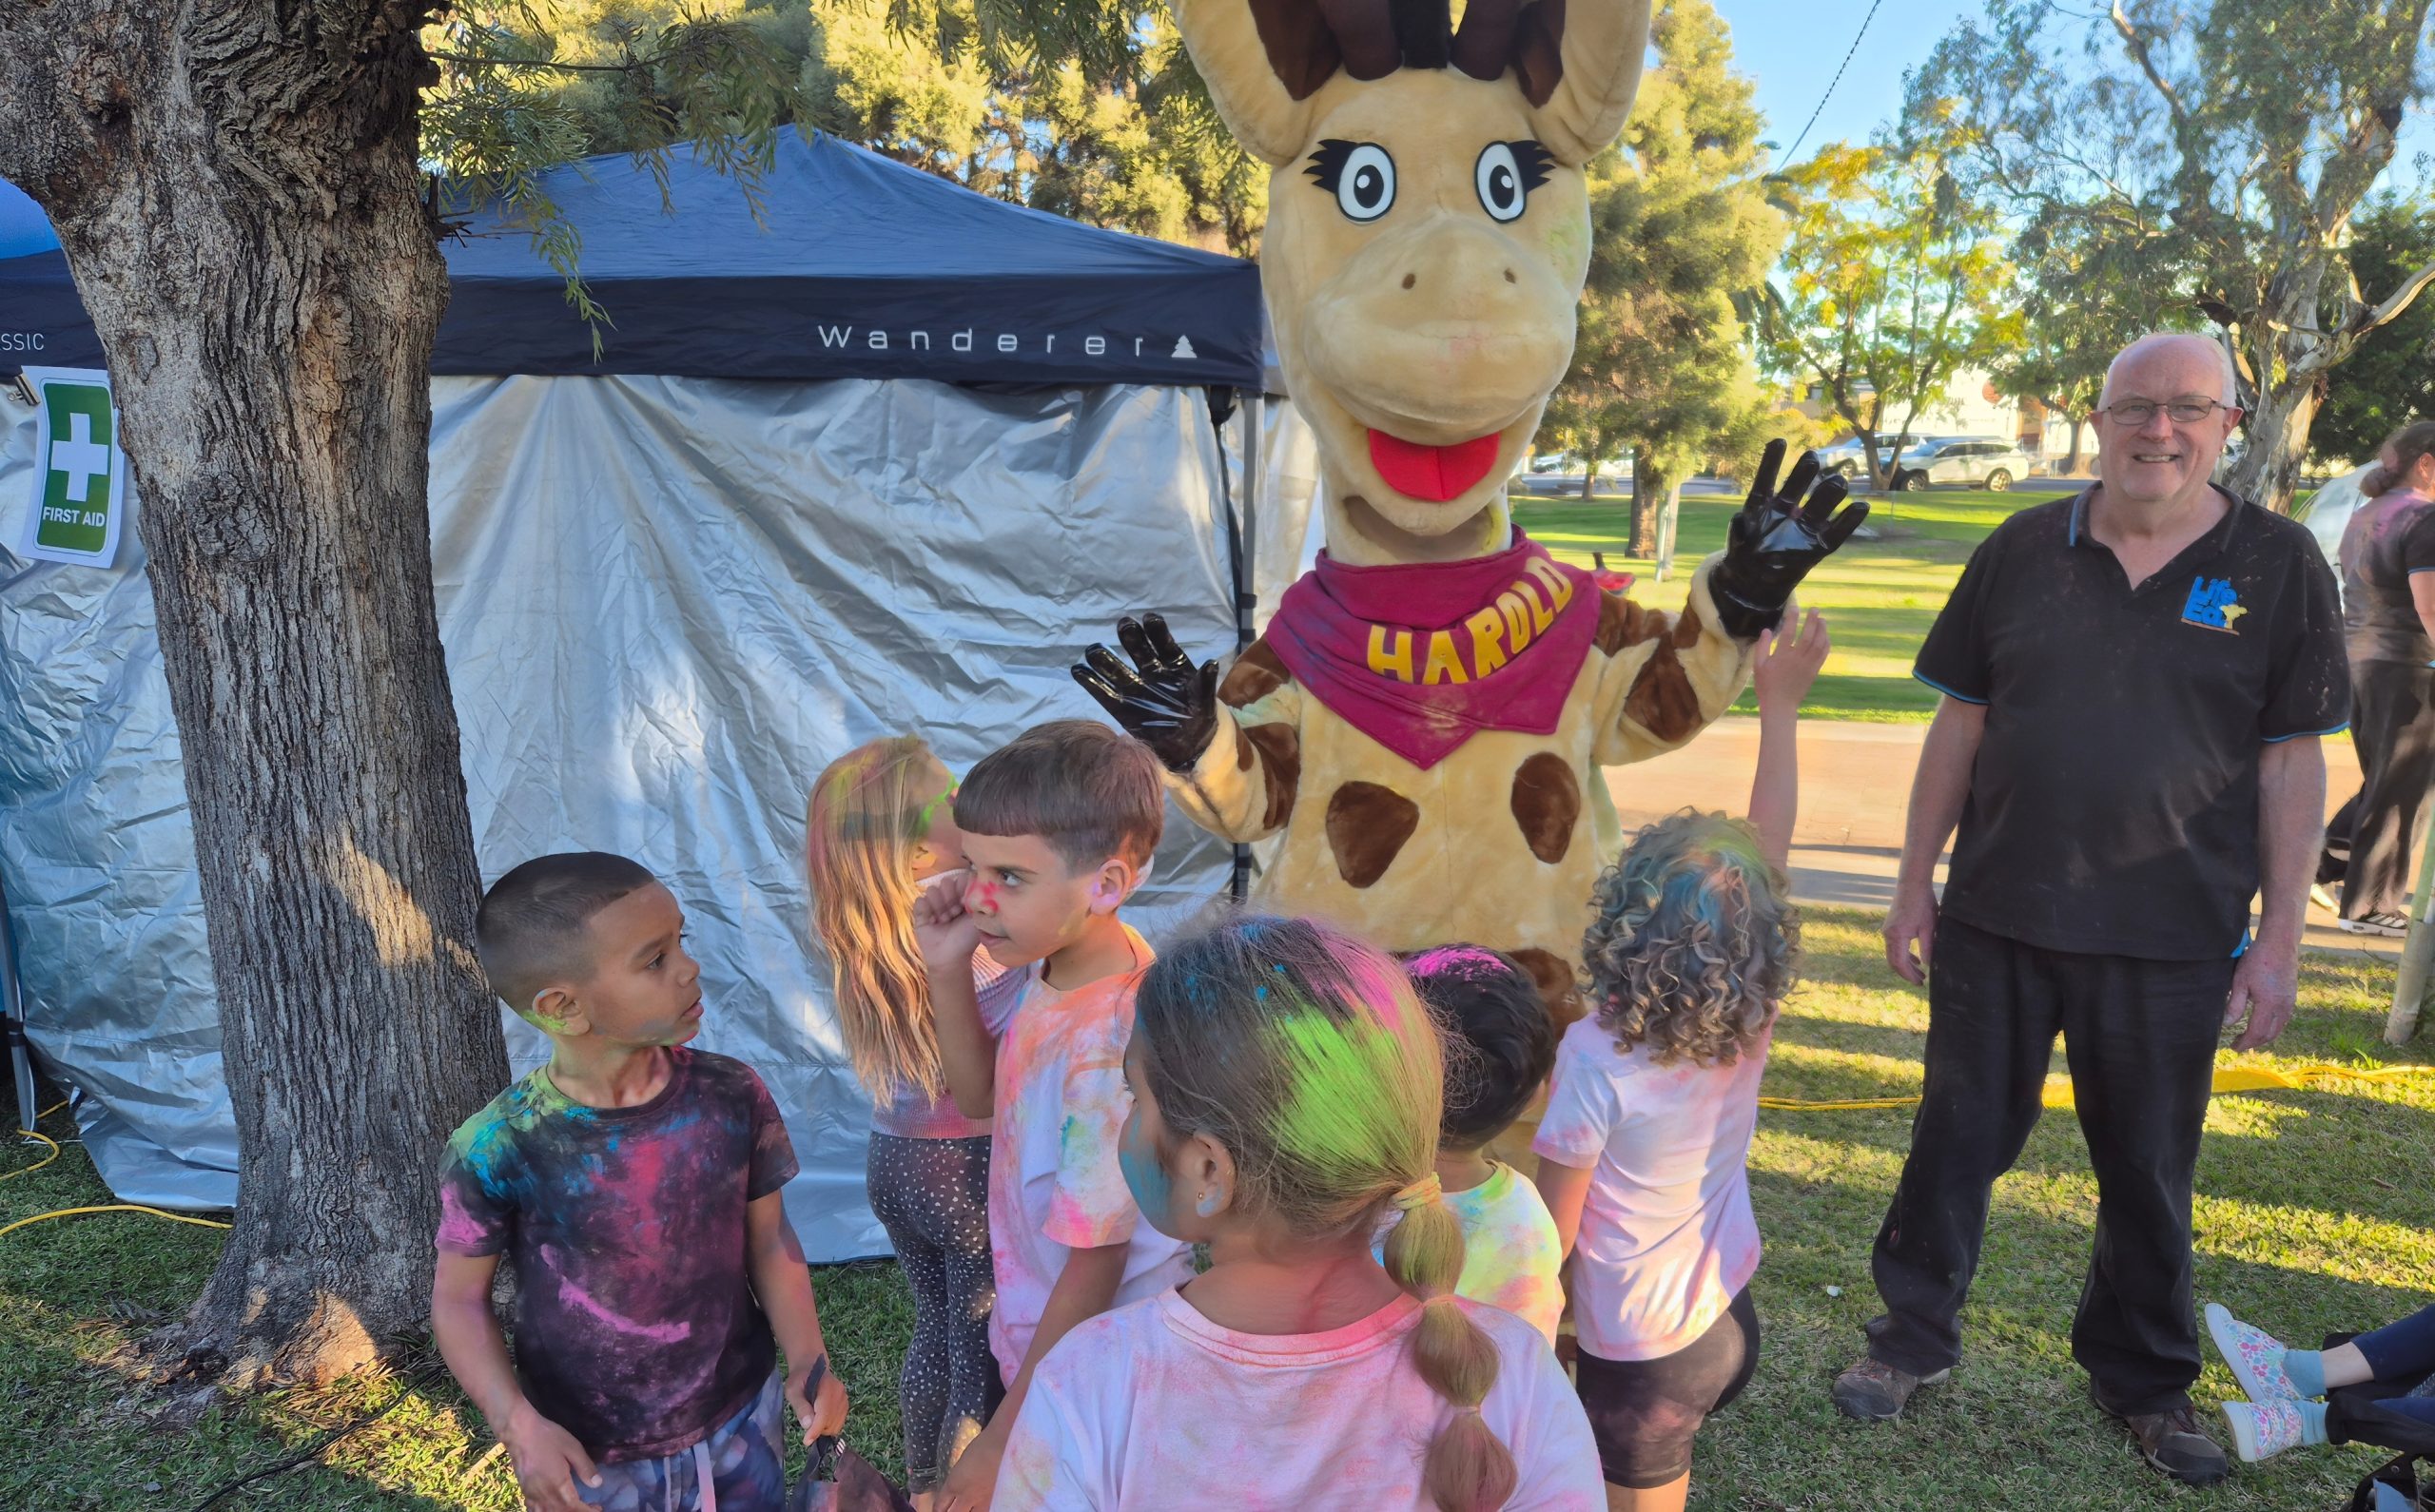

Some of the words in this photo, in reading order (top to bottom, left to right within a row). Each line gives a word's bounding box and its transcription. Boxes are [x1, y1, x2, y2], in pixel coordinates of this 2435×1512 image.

[0, 333, 45, 351] SSIC
[817, 324, 1143, 357] Wanderer
[42, 506, 81, 524] FIRST
[82, 511, 106, 527] AID
[1367, 556, 1573, 685] HAROLD
